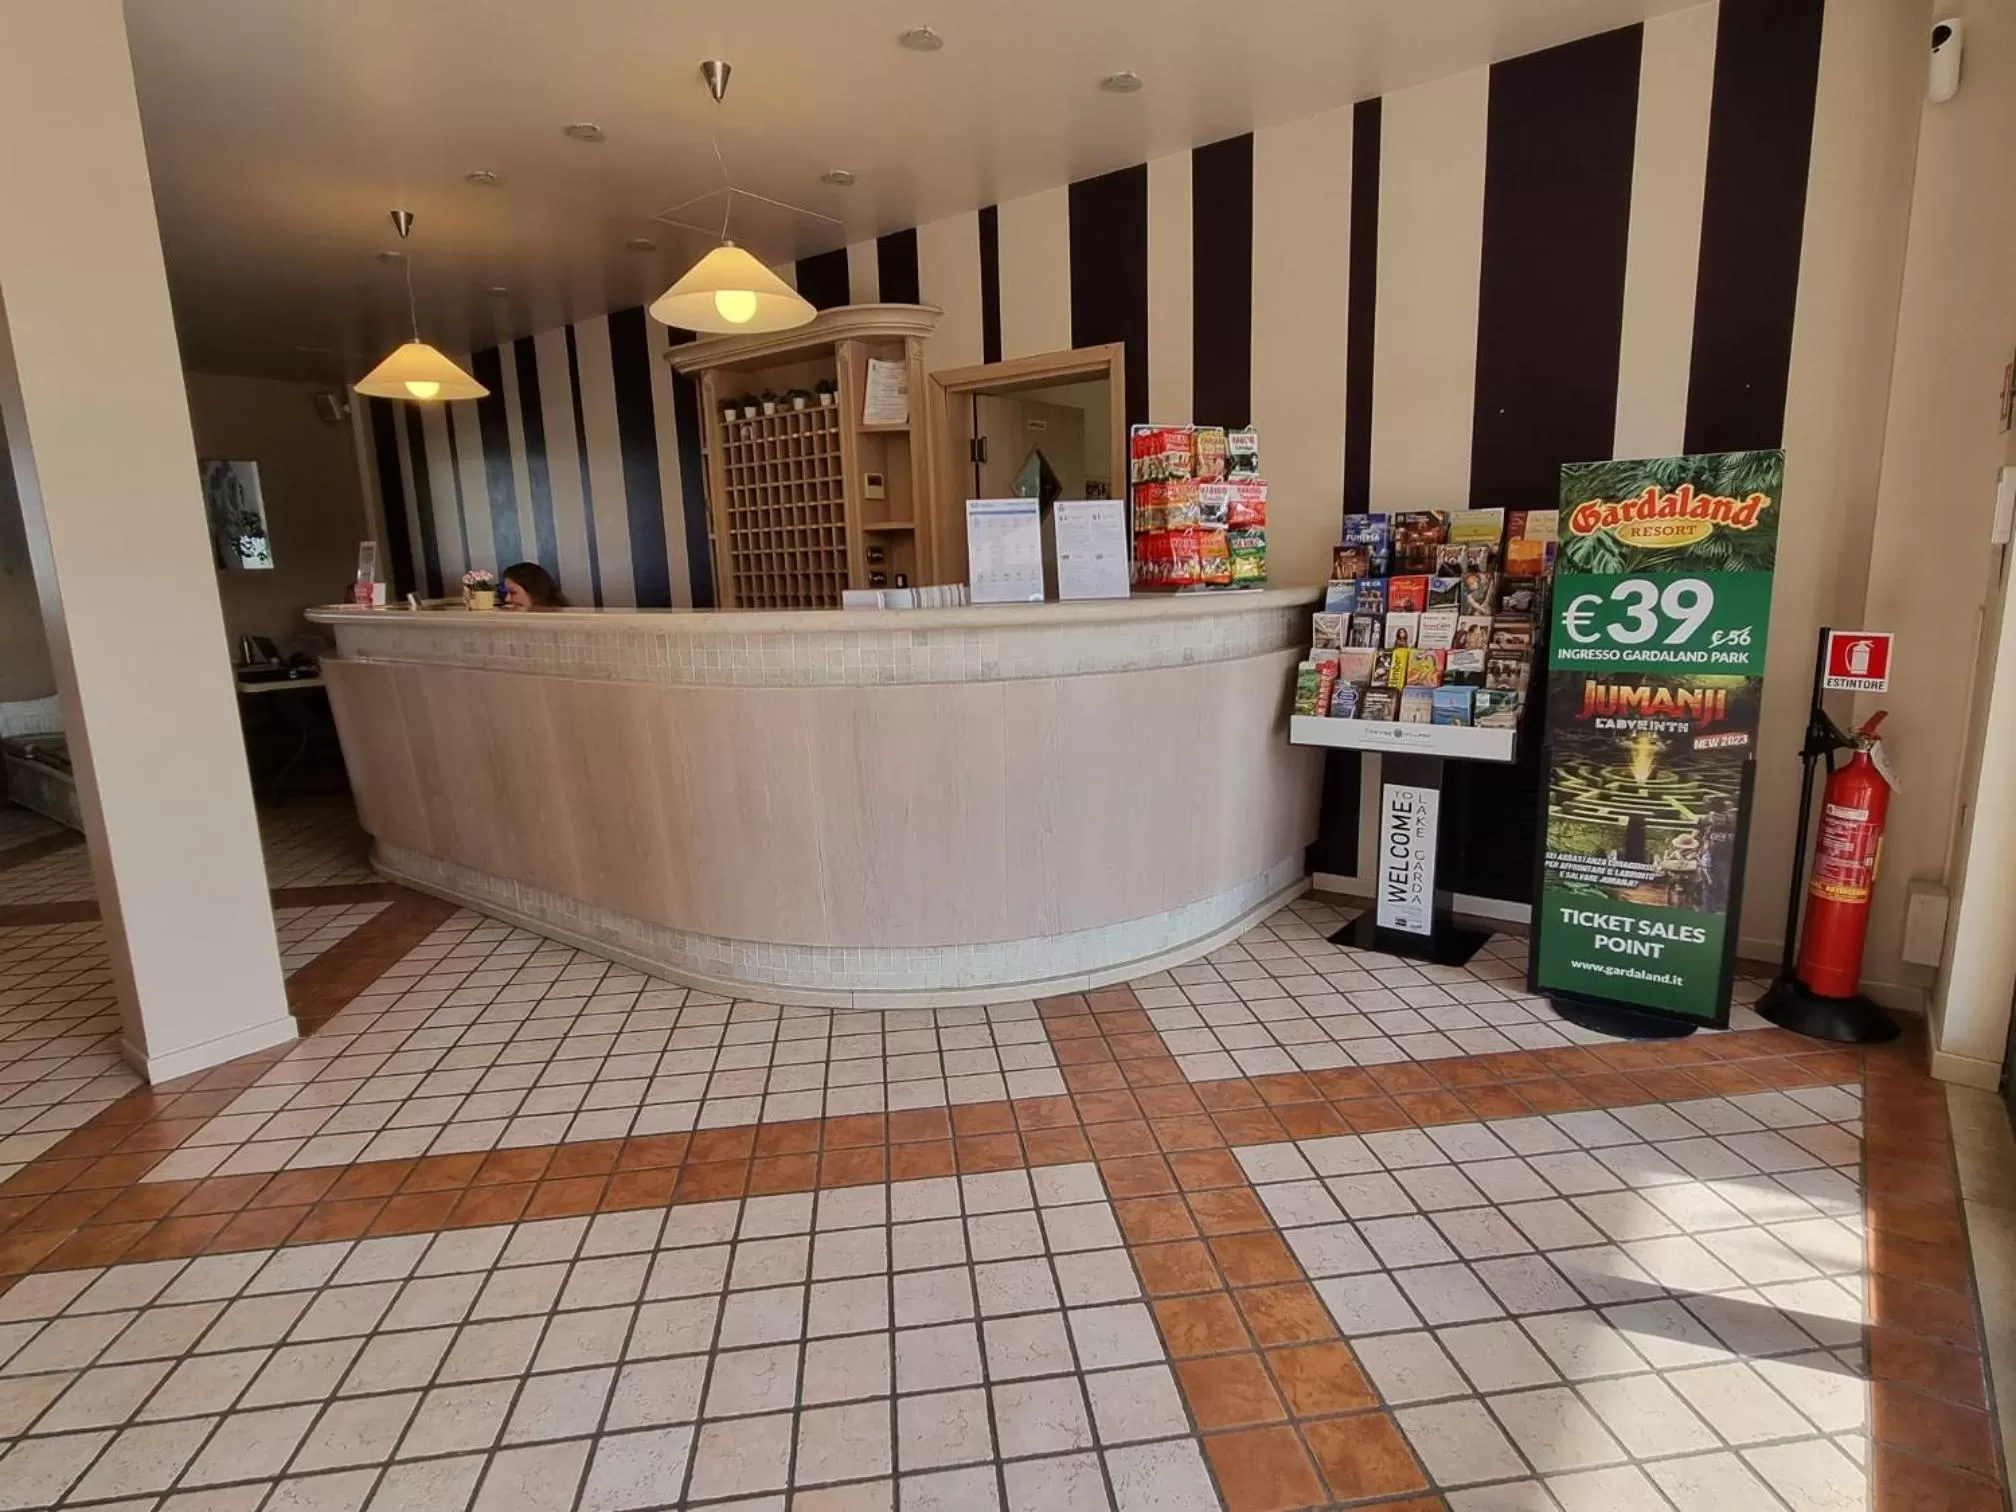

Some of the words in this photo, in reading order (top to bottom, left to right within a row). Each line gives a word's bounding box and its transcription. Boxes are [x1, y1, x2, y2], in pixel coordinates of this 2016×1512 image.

[1569, 484, 1771, 536] Gardaland
[1630, 524, 1697, 537] RESORT
[1558, 648, 1620, 661] INGRESSO
[1622, 649, 1708, 663] GARDALAND
[1711, 651, 1749, 664] PARK
[1826, 678, 1885, 691] ESTINTORE
[1576, 680, 1727, 729] JUMANJI
[1595, 718, 1689, 733] LABYRINTH
[1694, 735, 1720, 750] NEW
[1721, 734, 1748, 748] 2023
[1416, 794, 1427, 838] LAKE
[1387, 800, 1412, 903] WELCOME
[1560, 908, 1636, 933] TICKET
[1637, 920, 1706, 944] SALES
[1594, 934, 1665, 959] POINT
[1571, 960, 1684, 987] www.gardaland.it
